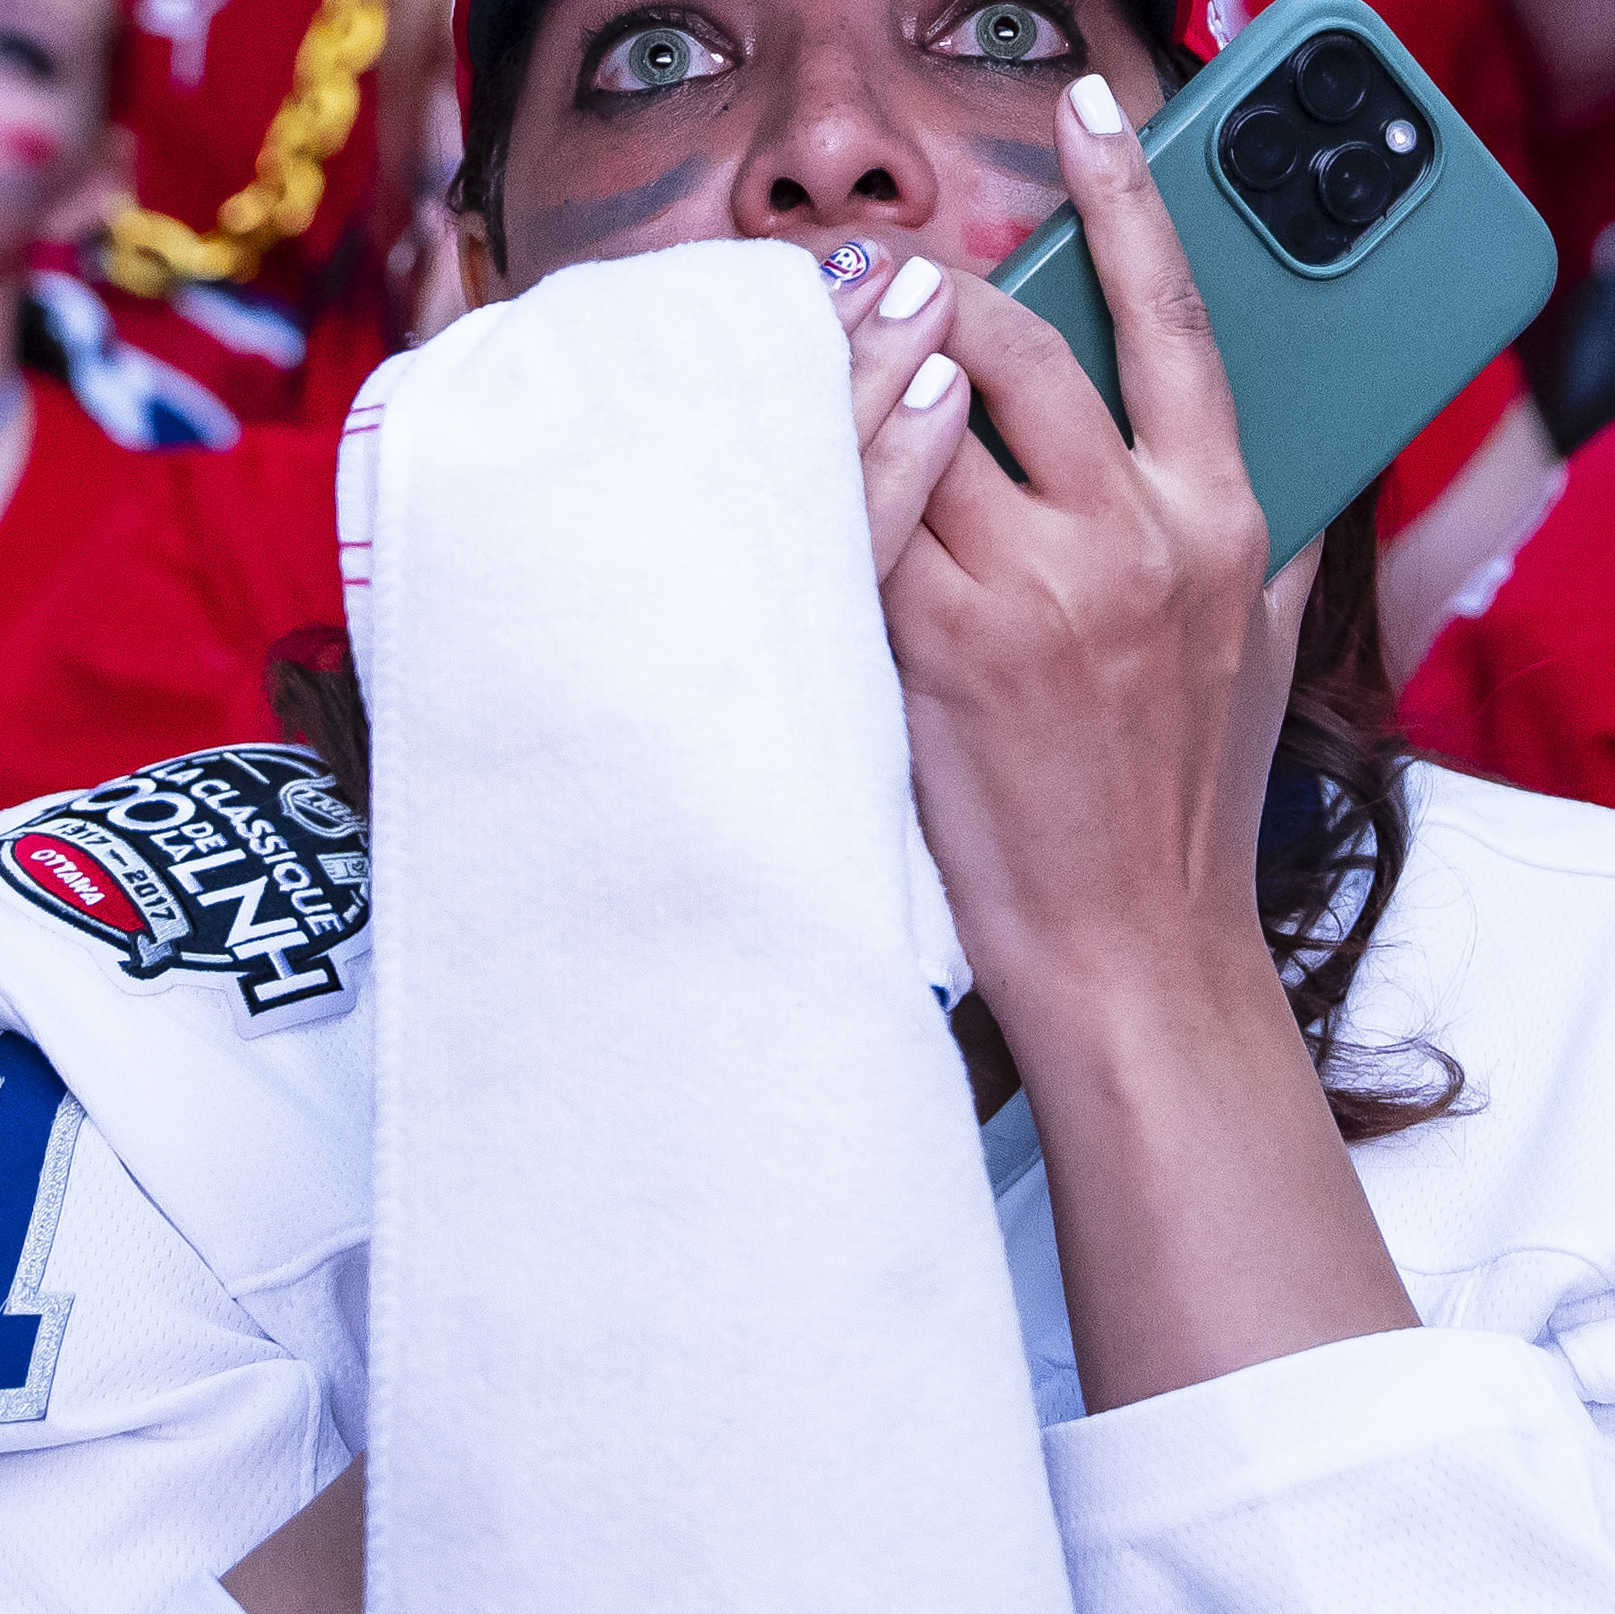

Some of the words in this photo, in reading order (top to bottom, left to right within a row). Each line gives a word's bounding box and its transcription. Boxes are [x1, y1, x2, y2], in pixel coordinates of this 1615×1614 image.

[150, 829, 195, 862] LA
[180, 820, 228, 853] DE
[190, 779, 346, 936] CLASSIQUE
[30, 849, 106, 907] OTTAWA
[122, 869, 176, 921] 2017
[167, 847, 329, 1003] LNH
